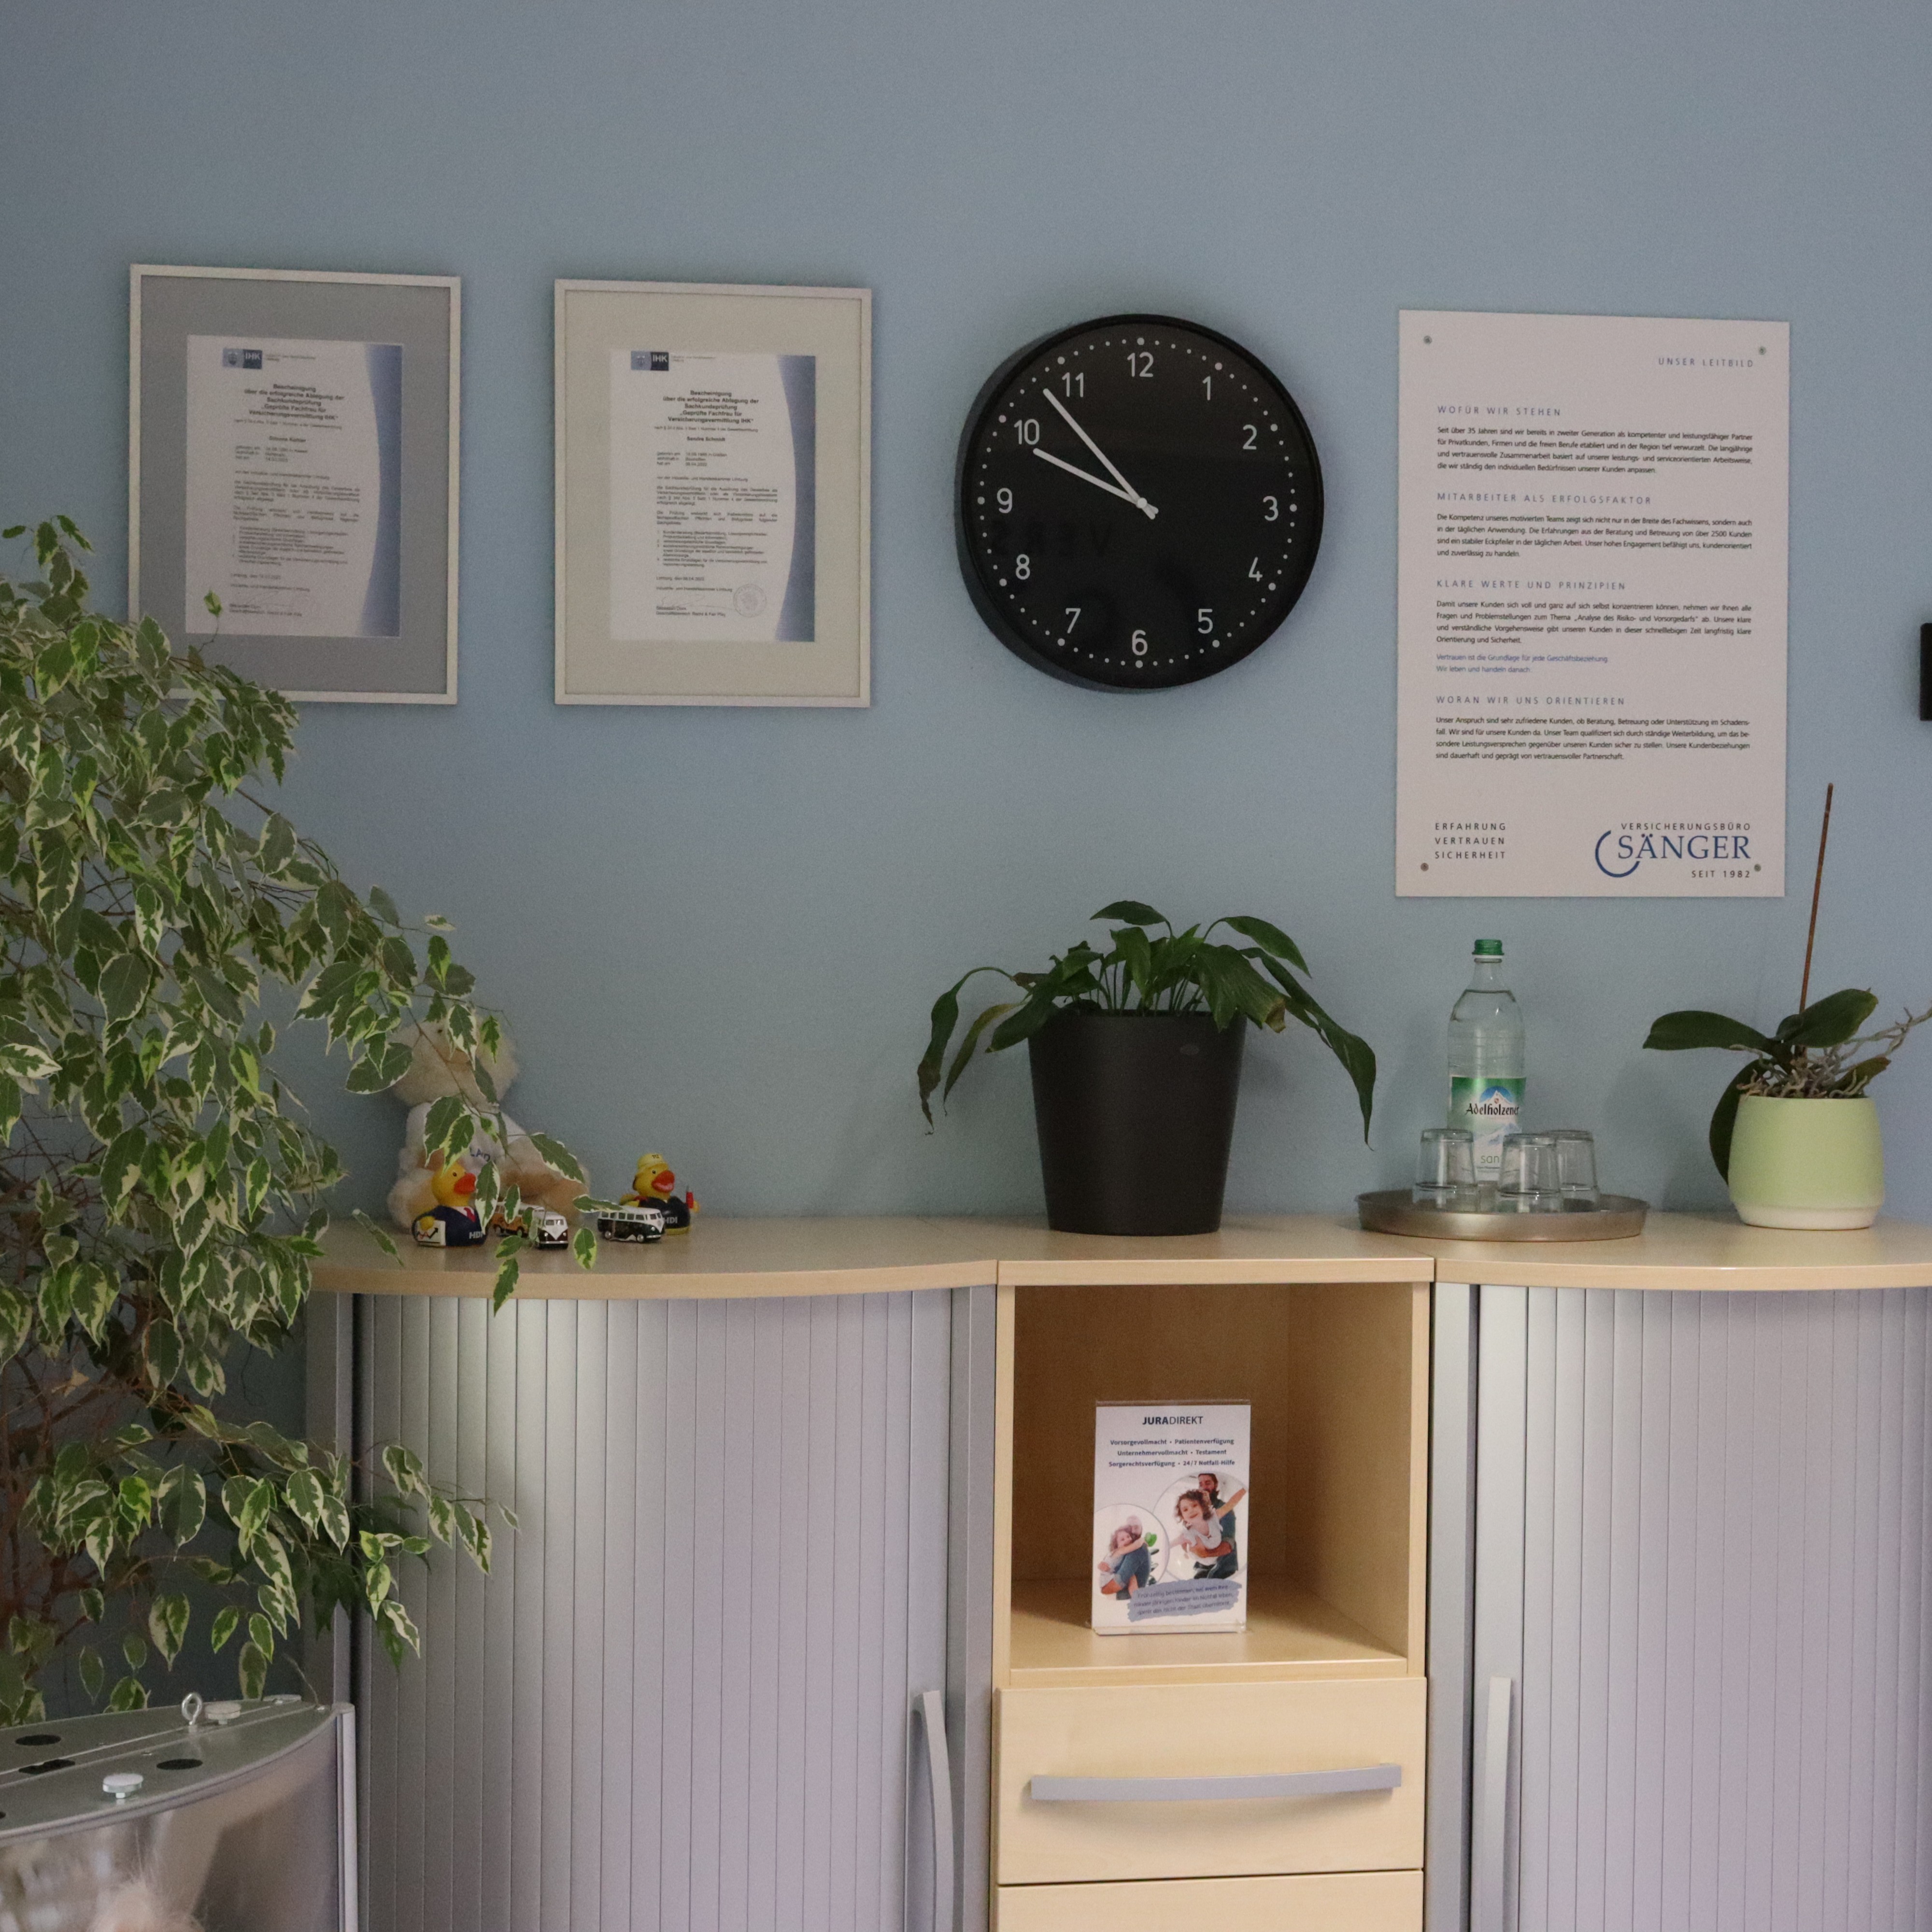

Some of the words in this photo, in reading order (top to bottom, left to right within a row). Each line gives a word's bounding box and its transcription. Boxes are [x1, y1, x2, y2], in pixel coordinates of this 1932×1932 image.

[1127, 351, 1153, 377] 12
[1658, 357, 1695, 366] UNSER
[1702, 358, 1753, 368] LEITBILD
[1062, 372, 1084, 397] 11
[1202, 376, 1211, 400] 1
[1437, 405, 1479, 414] WOFÜR
[1486, 406, 1508, 415] WIR
[1516, 407, 1560, 416] STEHEN
[1014, 418, 1040, 445] 10
[1242, 424, 1257, 450] 2
[1580, 429, 1615, 438] Generation
[1627, 430, 1666, 440] kompetenter
[996, 487, 1012, 513] 9
[1436, 492, 1516, 502] MITARBEITER
[1523, 494, 1544, 503] ALS
[1551, 494, 1650, 505] ERFOLGSFAKTOR
[1263, 496, 1278, 521] 3
[1457, 526, 1485, 534] täglichen
[1541, 526, 1579, 536] Erfahrungen
[1605, 528, 1633, 537] Beratung
[1648, 528, 1680, 538] Betreuung
[1450, 549, 1484, 558] zuverlässig
[1015, 554, 1030, 580] 8
[1248, 557, 1263, 582] 4
[1436, 579, 1473, 588] KLARE
[1480, 580, 1519, 589] WERTE
[1527, 581, 1551, 589] UND
[1558, 581, 1625, 590] PRINZIPIEN
[1065, 608, 1081, 634] 7
[1198, 609, 1213, 633] 5
[1546, 625, 1559, 634] gibt
[1704, 626, 1734, 636] langfristig
[1132, 629, 1148, 655] 6
[1435, 696, 1479, 704] WORAN
[1486, 696, 1508, 704] WIR
[1516, 696, 1538, 705] UNS
[1546, 696, 1624, 705] ORIENTIEREN
[1528, 740, 1561, 749] gegenüber
[1494, 753, 1520, 761] geprägt
[1435, 822, 1506, 831] ERFAHRUNG
[1620, 821, 1750, 831] VERSICHERUNGSBÜRO
[1434, 836, 1505, 845] VERTRAUEN
[1617, 833, 1752, 860] SÄNGER
[1434, 850, 1506, 859] SICHERHEIT
[1690, 869, 1715, 878] SEIT
[1722, 869, 1750, 878] 1982
[1142, 1416, 1204, 1425] JURADIREKT
